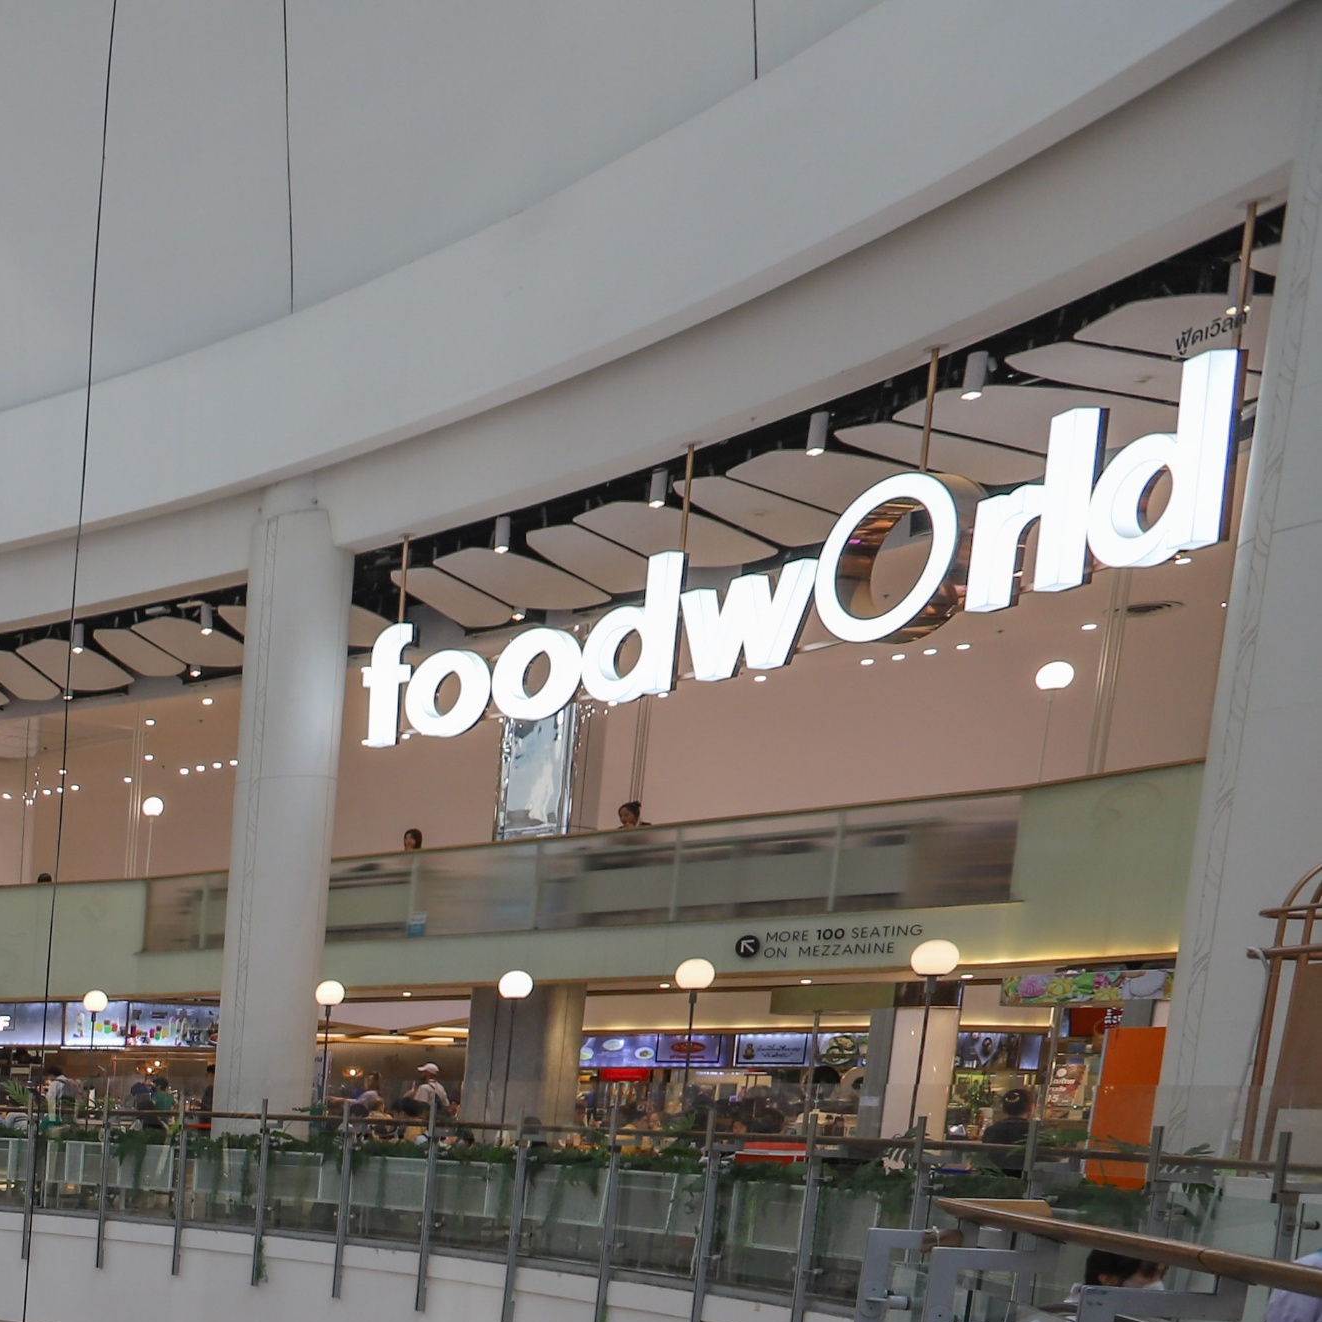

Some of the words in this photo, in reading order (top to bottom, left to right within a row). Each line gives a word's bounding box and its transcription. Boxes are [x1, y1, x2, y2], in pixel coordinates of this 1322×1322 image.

[765, 930, 809, 943] MORE
[816, 928, 846, 941] 100
[851, 924, 924, 939] SEATING
[763, 946, 787, 959] ON
[798, 942, 895, 957] MEZZANINE
